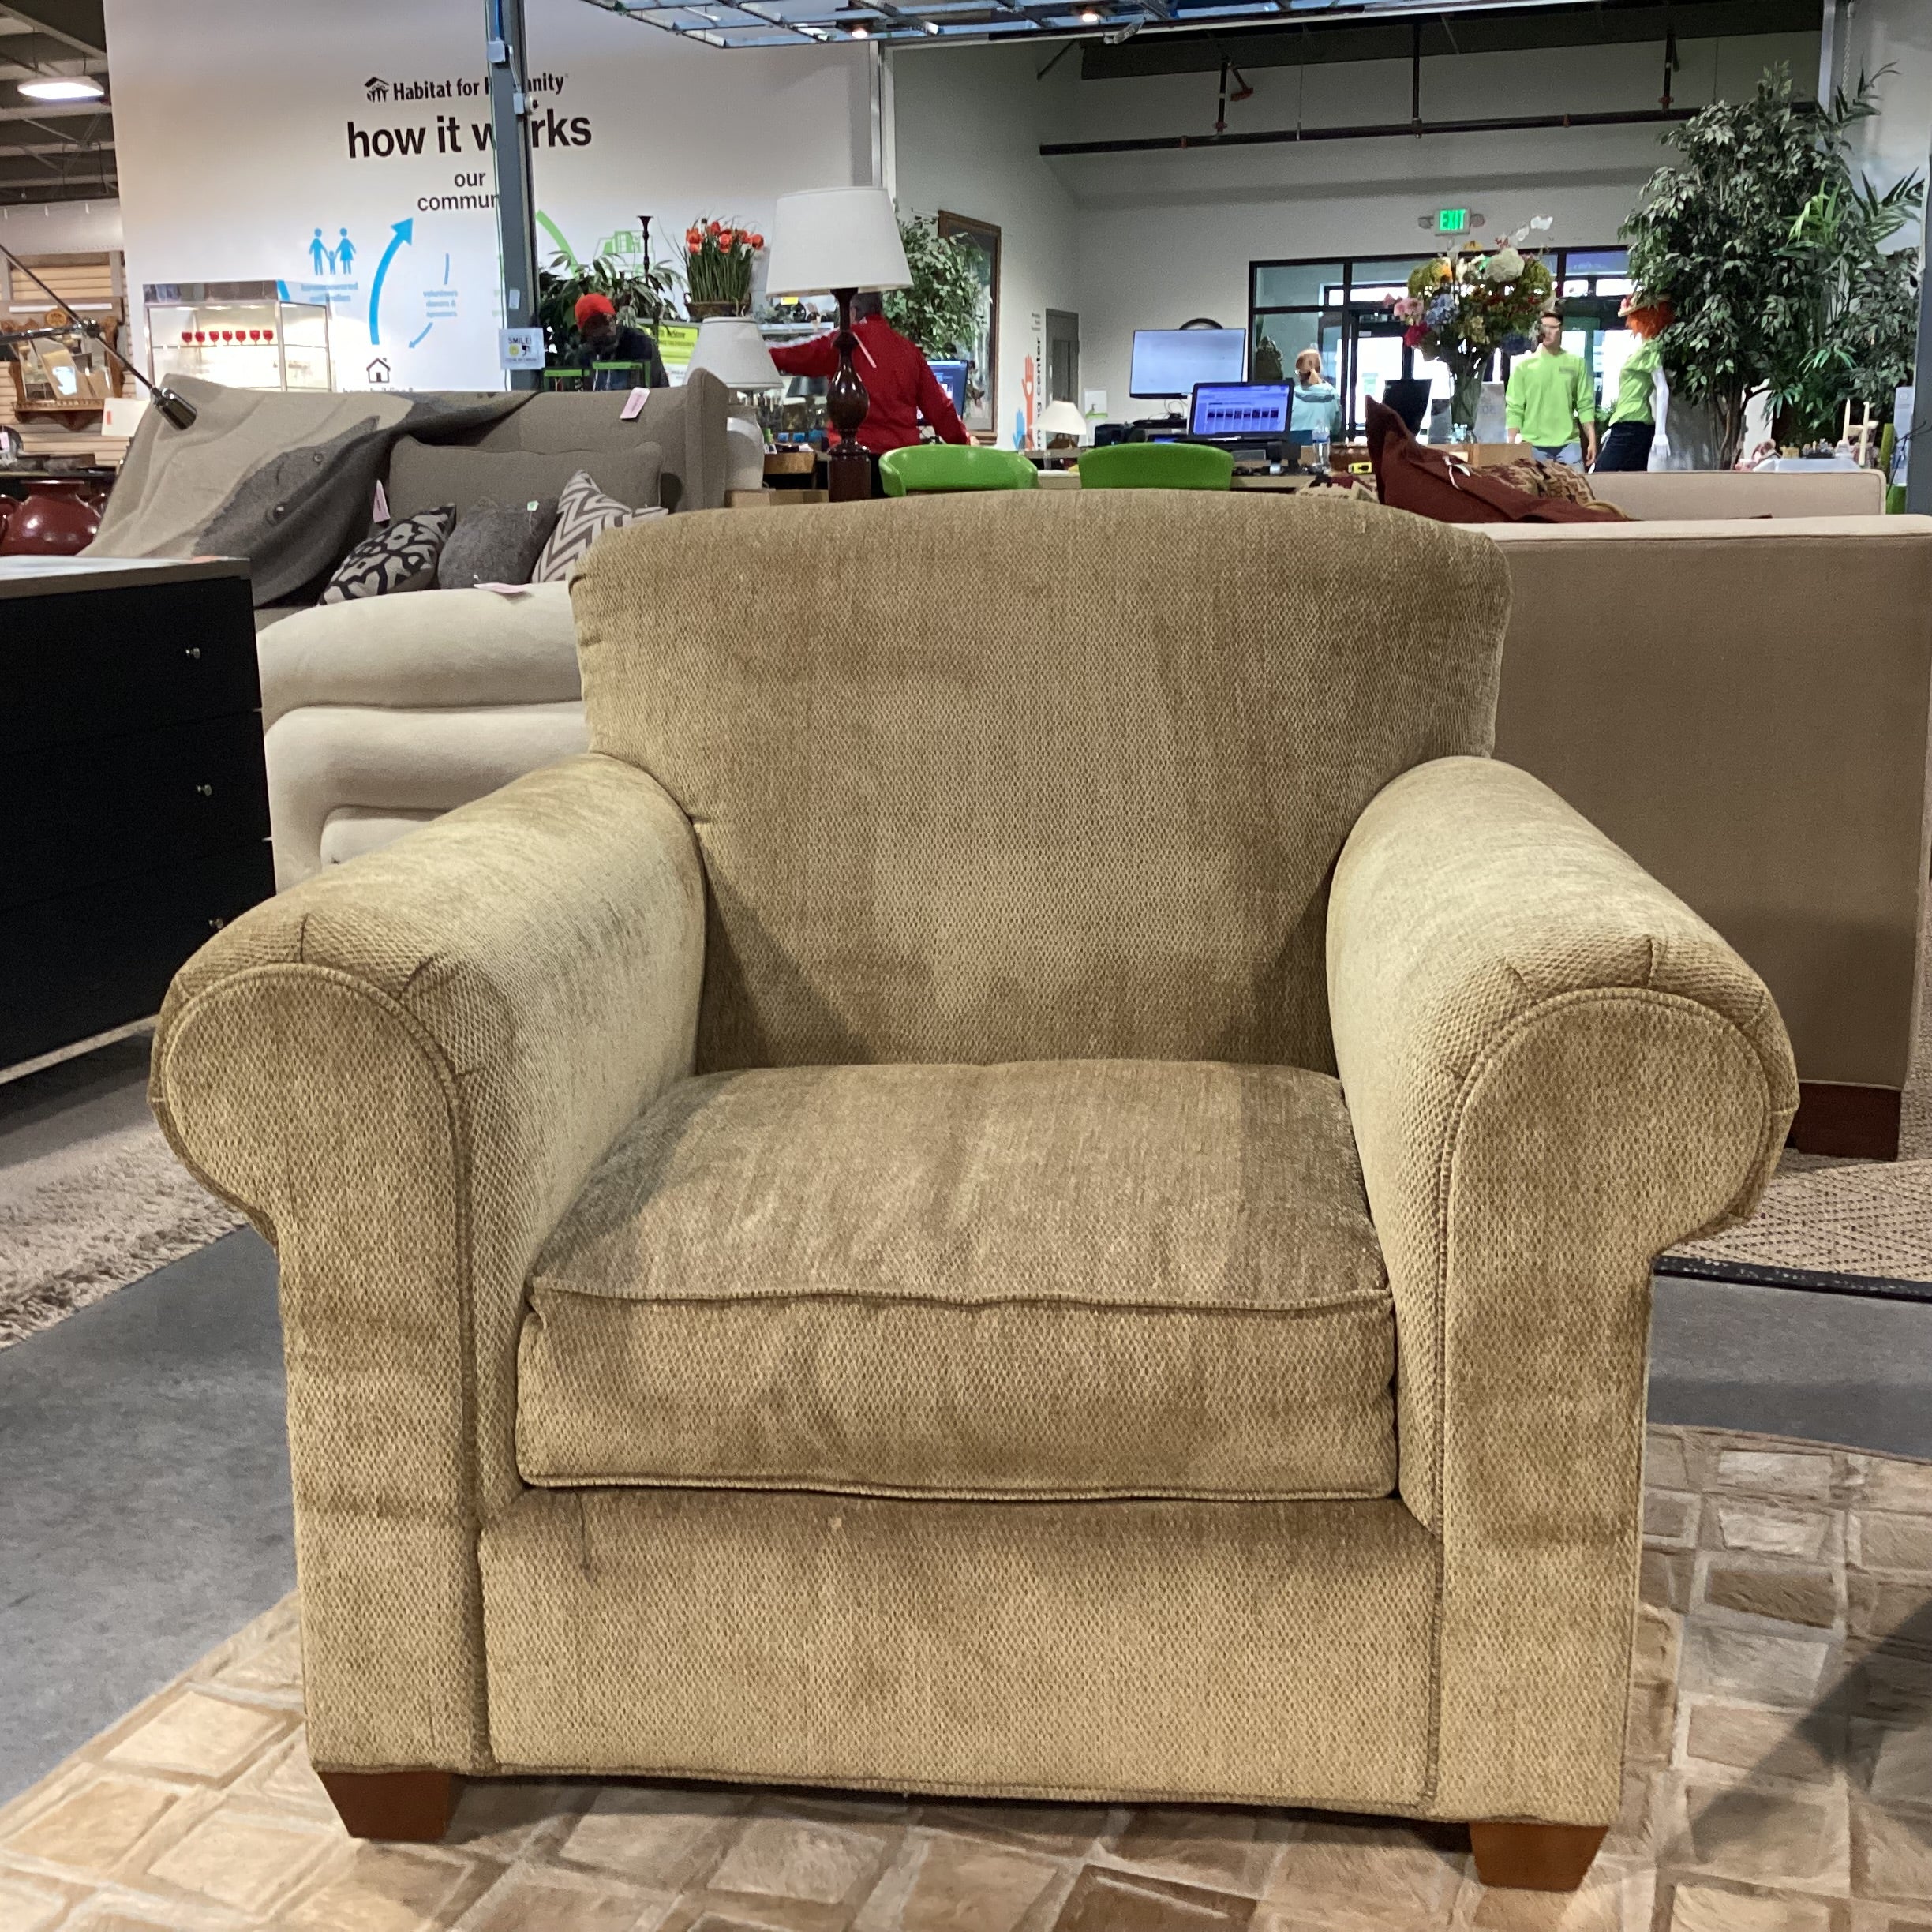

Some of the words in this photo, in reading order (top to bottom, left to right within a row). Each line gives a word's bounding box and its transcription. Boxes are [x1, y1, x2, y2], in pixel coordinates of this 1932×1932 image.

[393, 80, 452, 101] Habitat
[457, 78, 480, 96] for
[485, 73, 564, 95] nity
[347, 122, 426, 159] how
[436, 115, 462, 153] it
[472, 109, 592, 151] wrks
[454, 172, 487, 188] our
[417, 193, 500, 212] commun
[1440, 209, 1466, 230] EXIT
